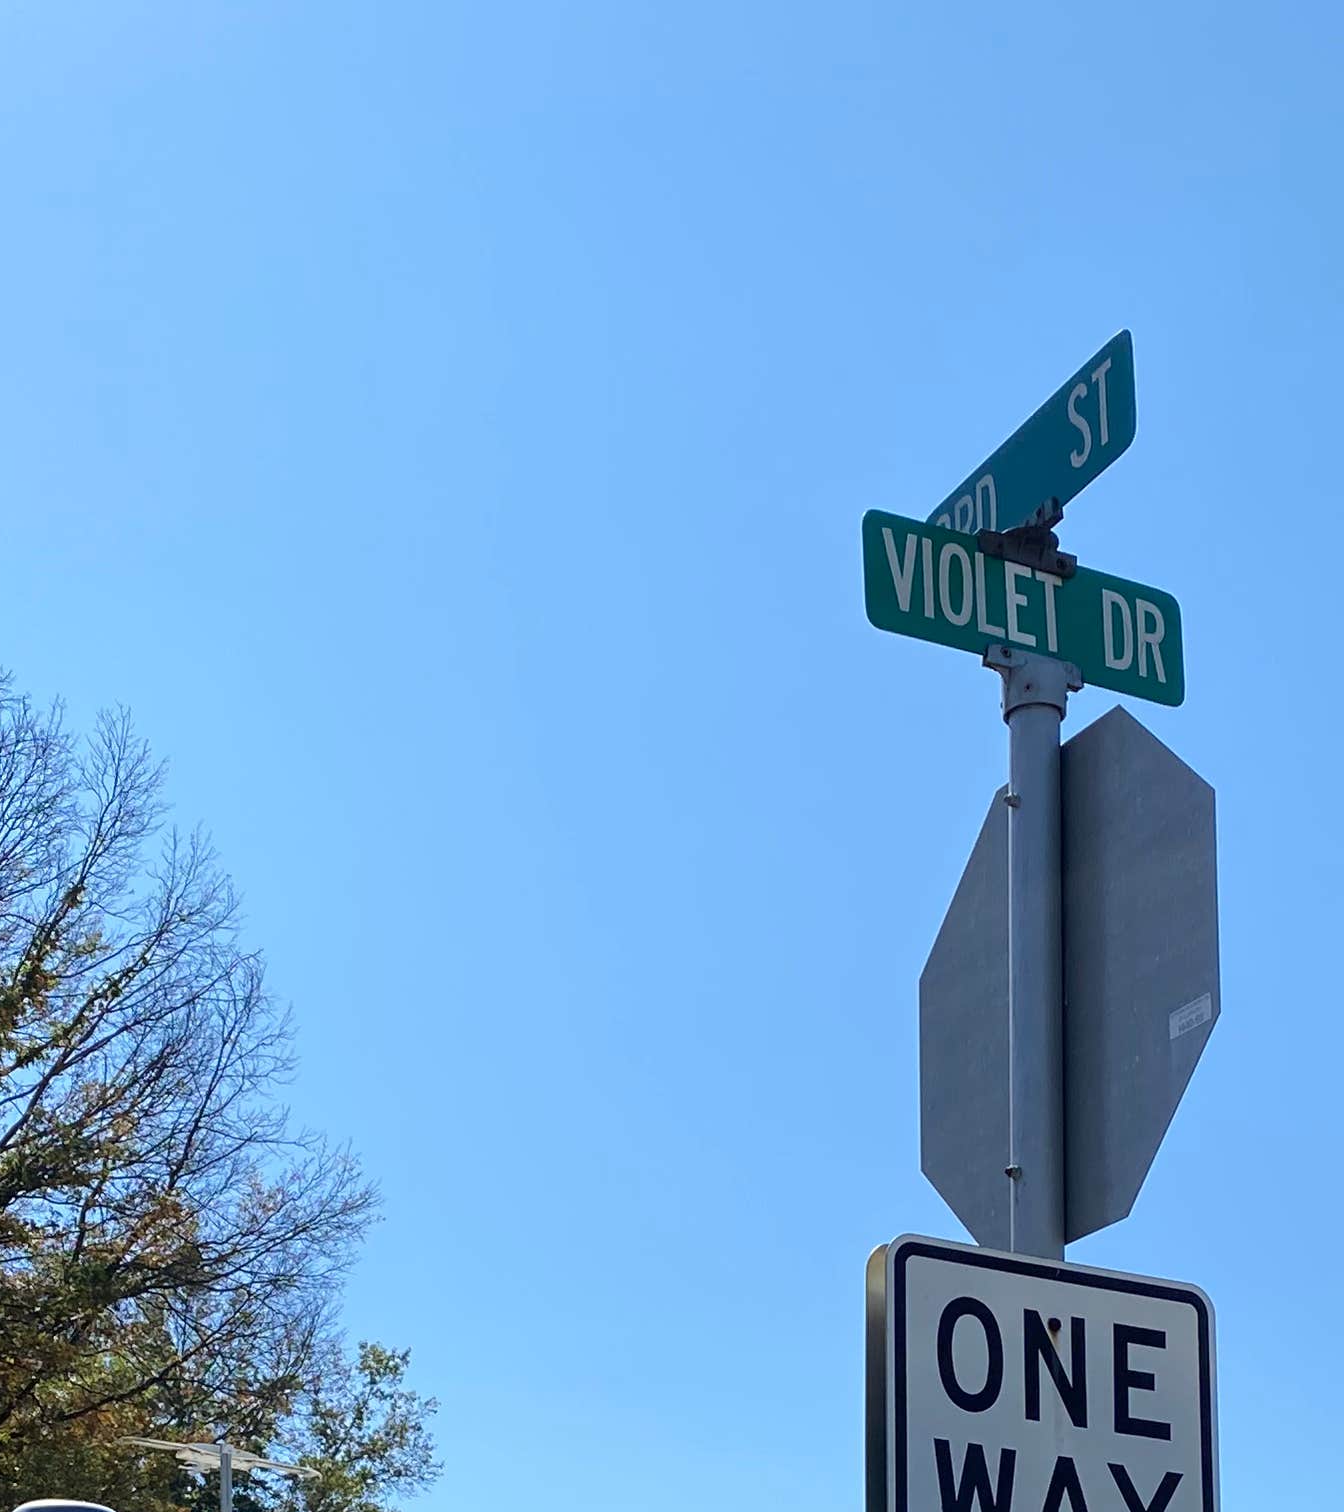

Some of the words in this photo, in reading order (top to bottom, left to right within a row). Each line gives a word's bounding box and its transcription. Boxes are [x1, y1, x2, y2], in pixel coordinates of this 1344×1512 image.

[1067, 358, 1111, 468] ST
[882, 527, 1062, 652] VIOLET
[1102, 588, 1167, 683] DR
[937, 1296, 1172, 1441] ONE
